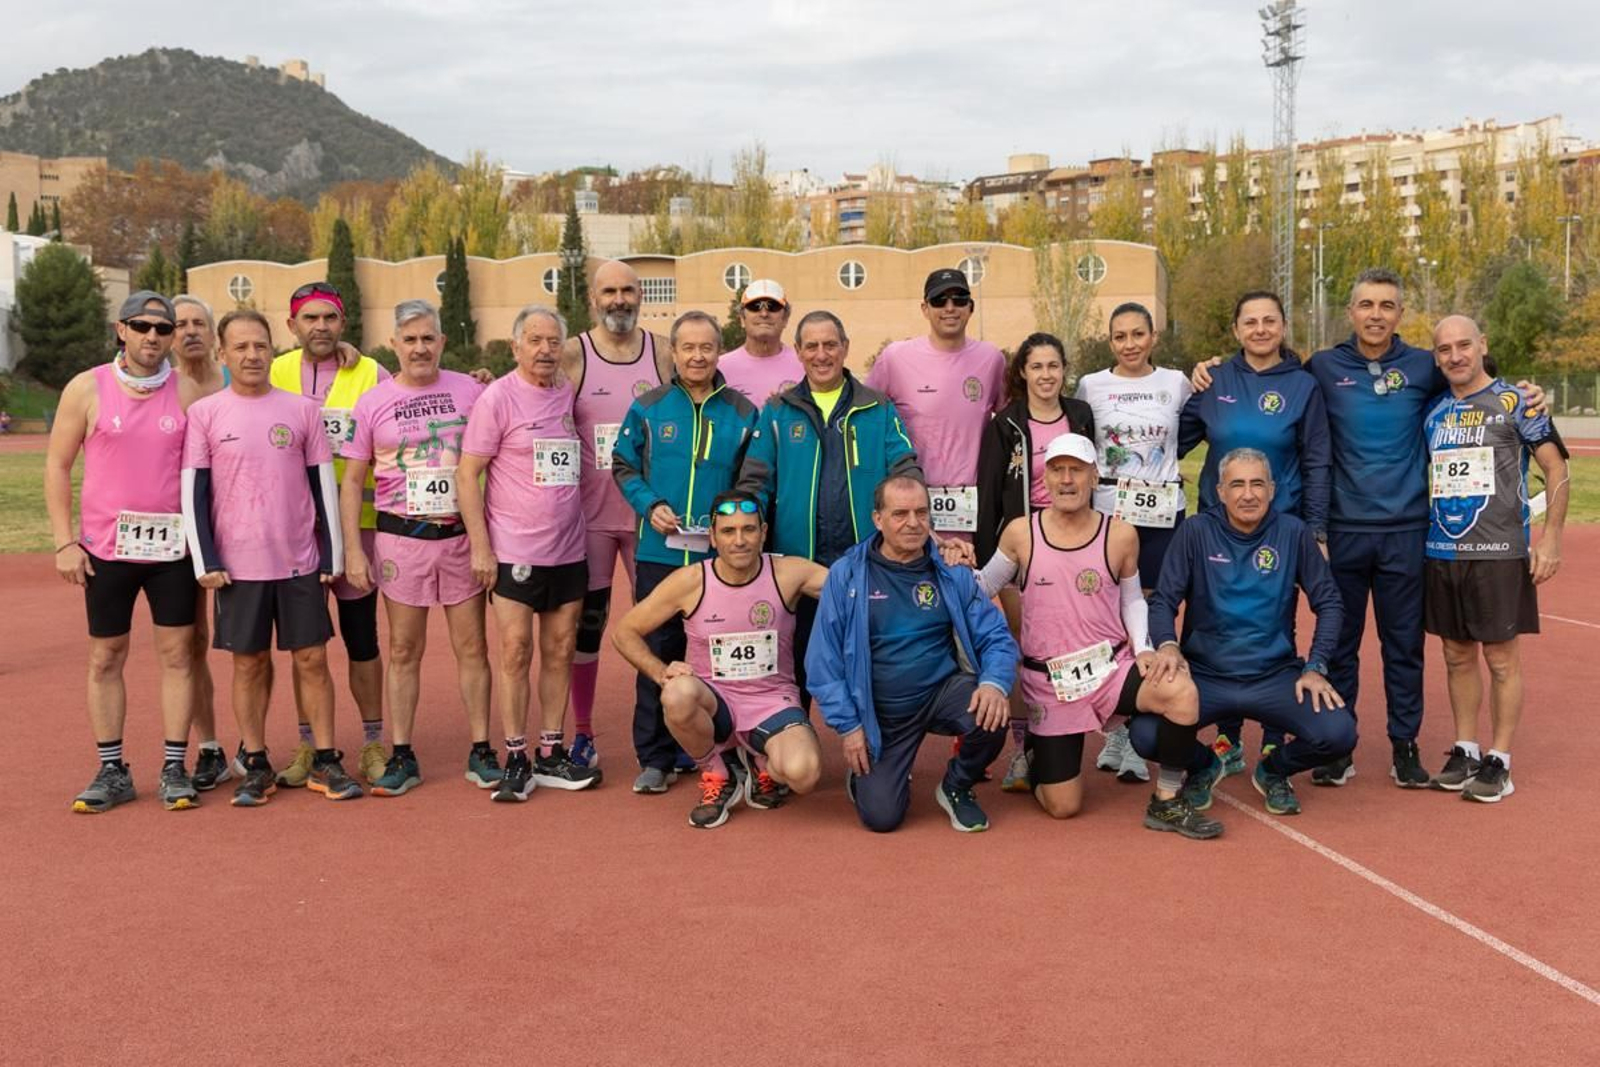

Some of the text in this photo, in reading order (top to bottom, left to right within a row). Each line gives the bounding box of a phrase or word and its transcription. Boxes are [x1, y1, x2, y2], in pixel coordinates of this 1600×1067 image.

[428, 398, 438, 406] DE
[393, 403, 457, 421] PUENTES
[1459, 410, 1485, 428] SOY
[1433, 425, 1486, 449] DIABLO
[551, 451, 570, 466] 62
[1448, 462, 1470, 477] 82
[425, 479, 449, 495] 40
[933, 497, 956, 512] 80
[1134, 492, 1157, 508] 58
[131, 525, 168, 541] 111
[1458, 543, 1475, 552] DEL
[1476, 542, 1510, 552] DIABLO
[730, 645, 756, 661] 48
[1071, 662, 1093, 680] 11
